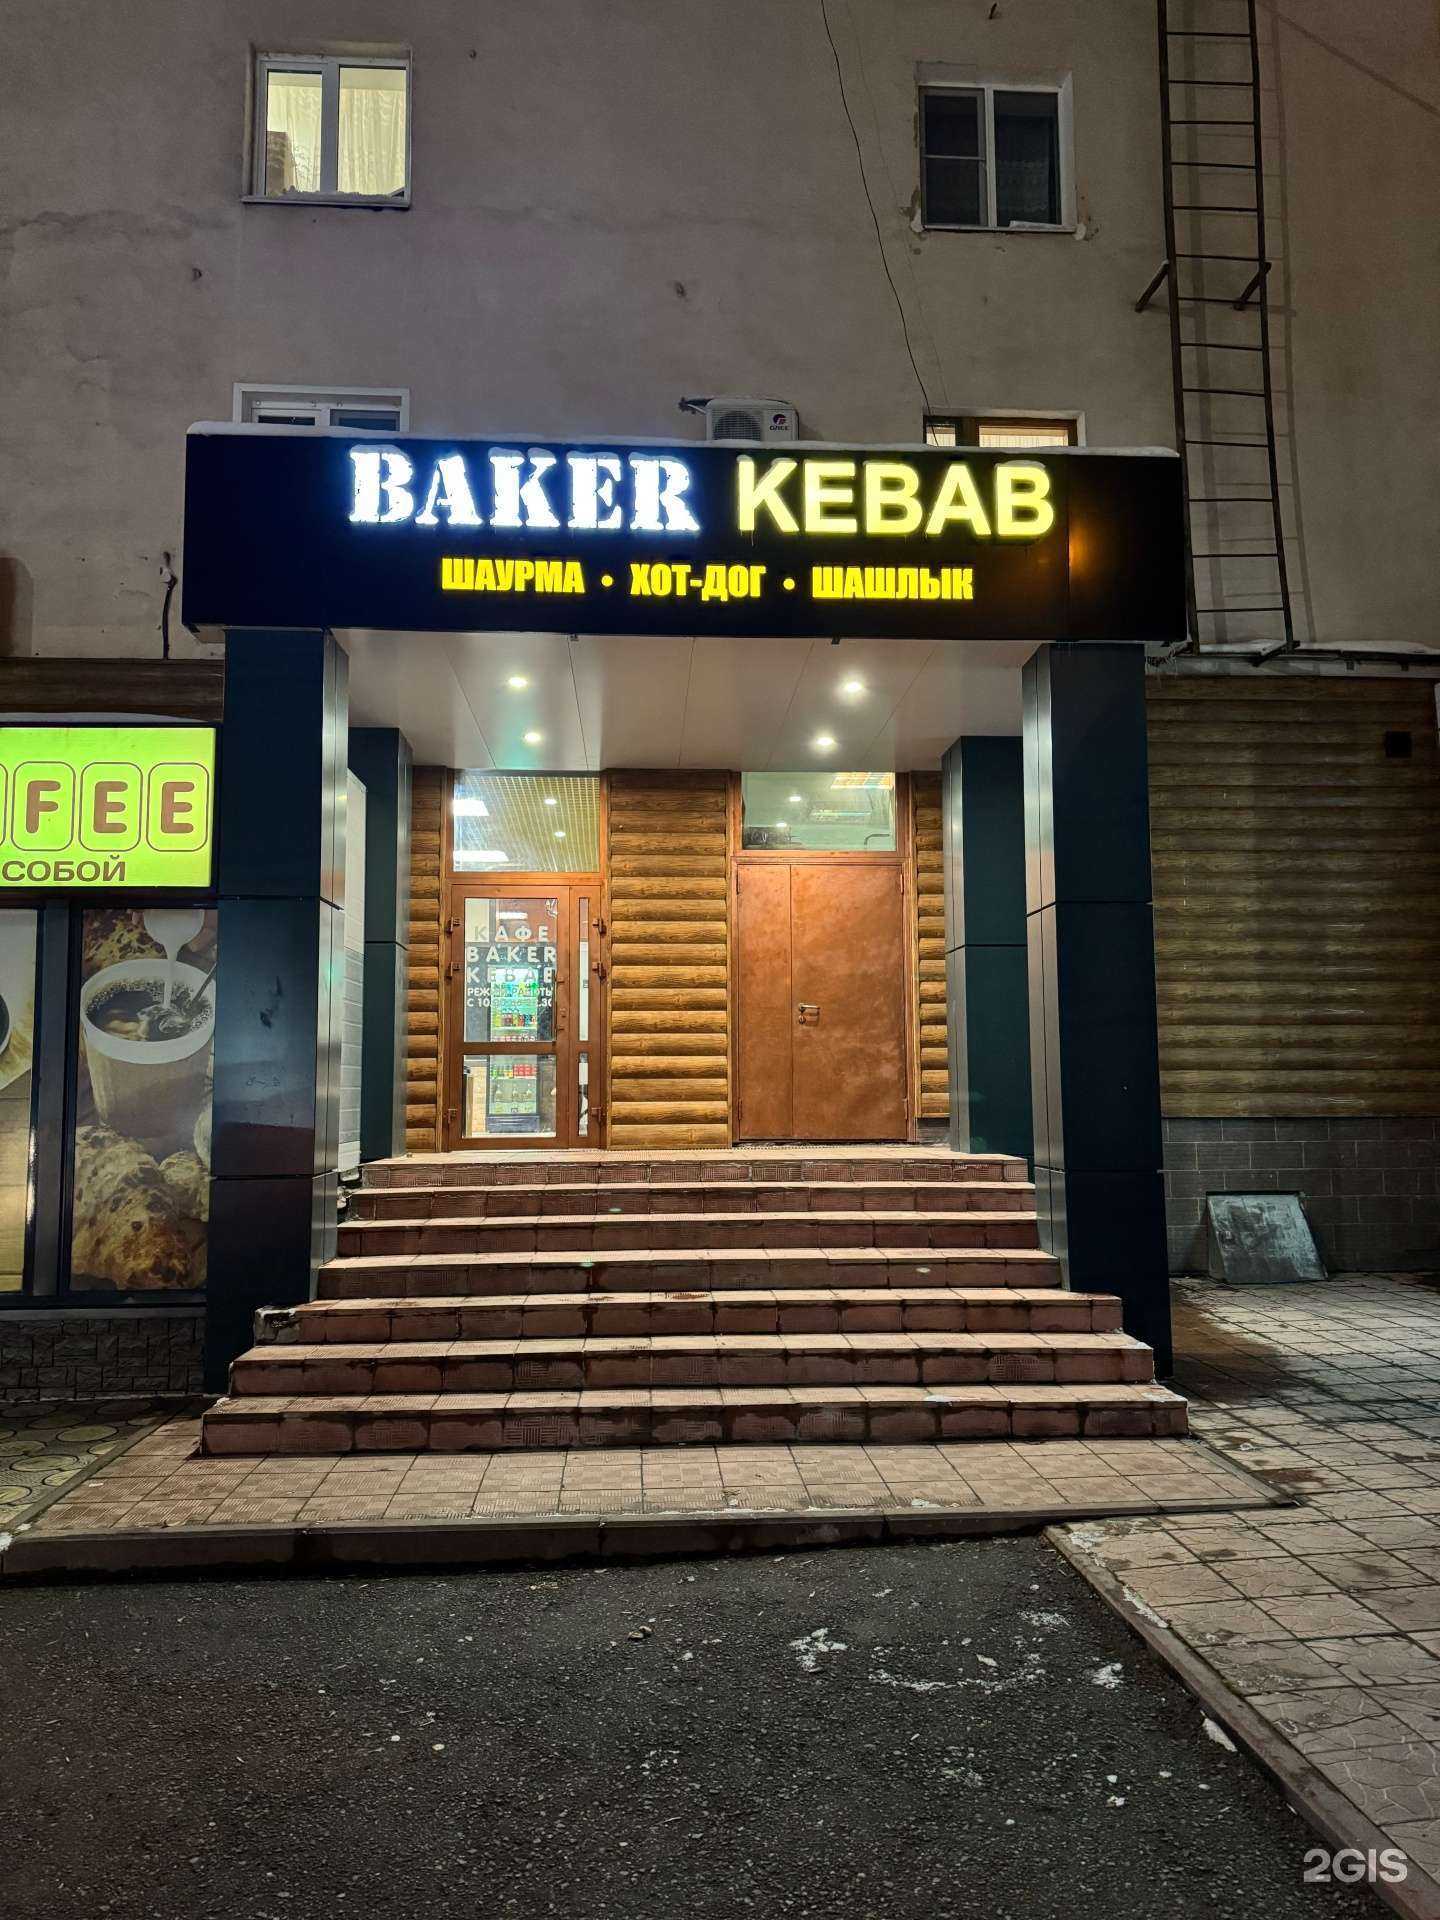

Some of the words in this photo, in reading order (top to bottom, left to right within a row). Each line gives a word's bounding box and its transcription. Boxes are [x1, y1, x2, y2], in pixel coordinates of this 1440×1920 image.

[349, 445, 701, 532] BAKER
[737, 456, 1055, 537] KEBAB
[441, 557, 586, 594] ШАУРМА
[630, 562, 767, 602] ХОТ-ДОГ
[812, 565, 975, 601] ШАШЛЫК
[25, 779, 196, 834] FEE
[1, 854, 126, 882] СОБОЙ
[474, 925, 550, 942] КАФЕ
[466, 945, 557, 963] BAKER
[466, 966, 553, 984] KEBAB
